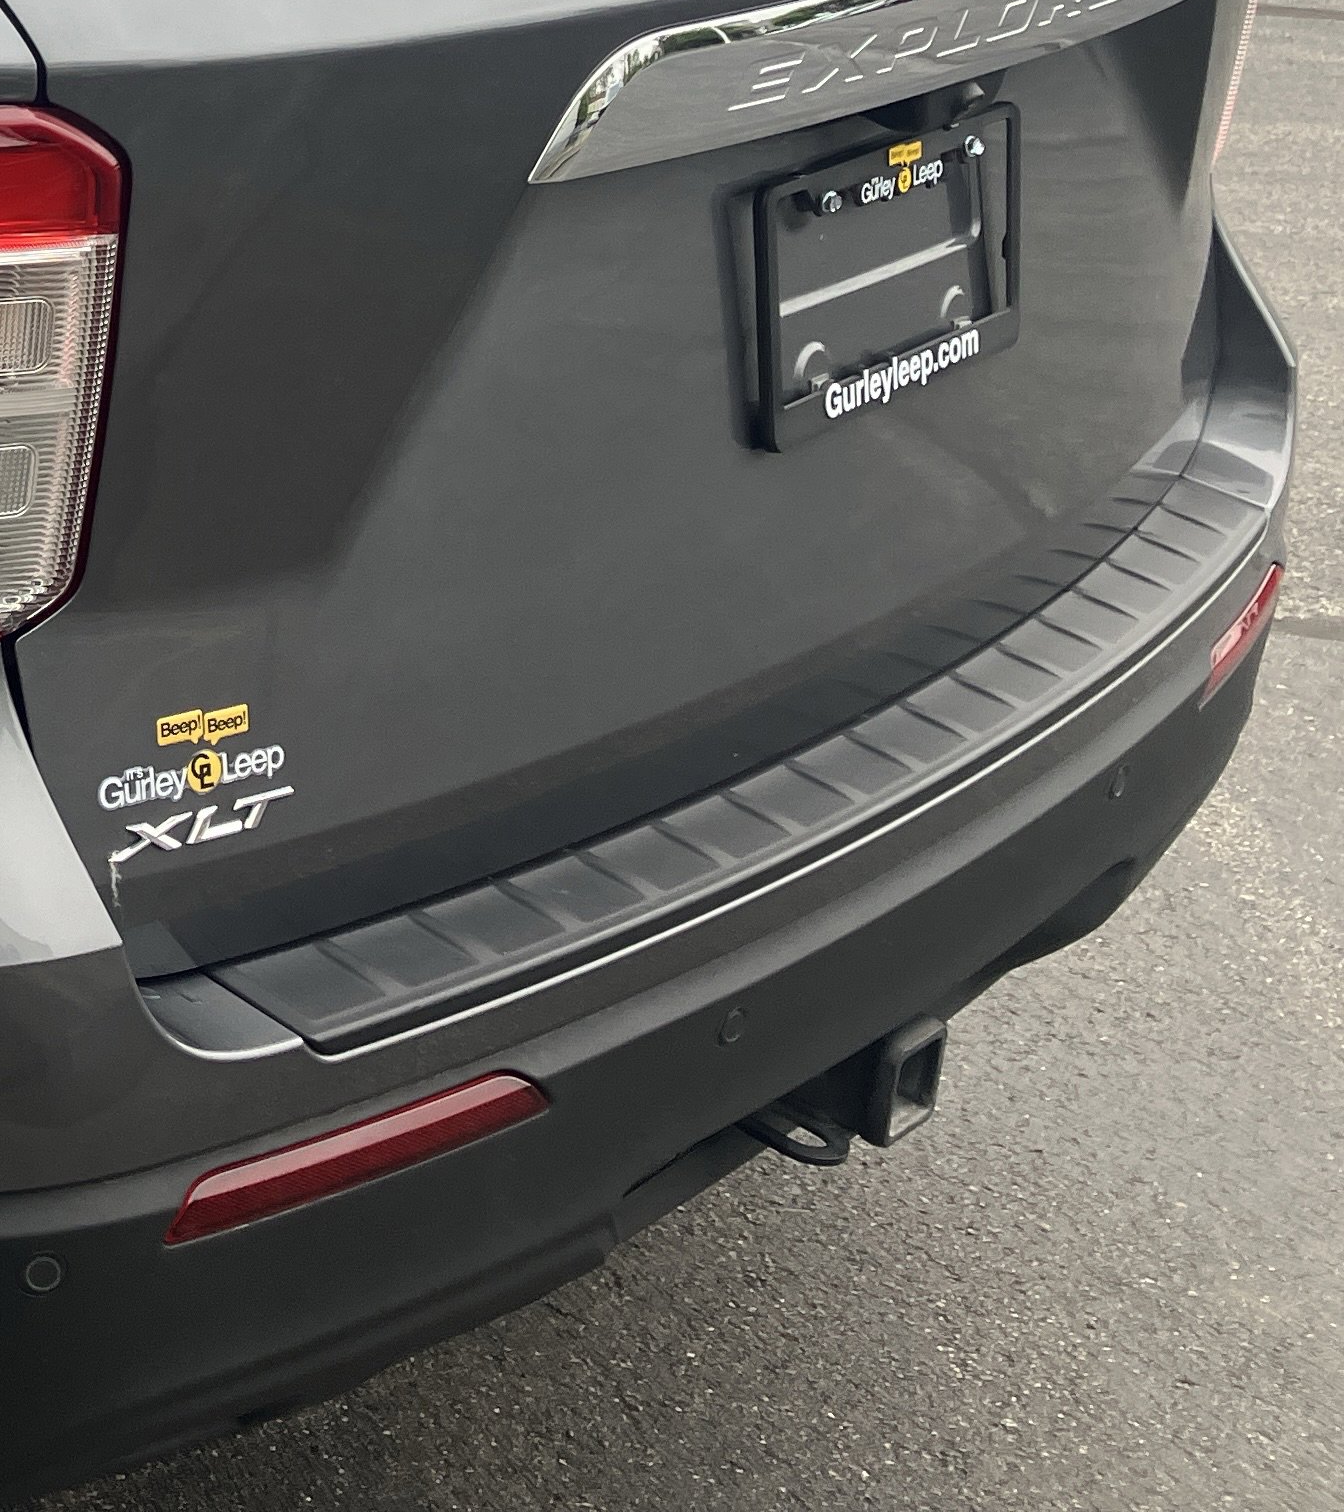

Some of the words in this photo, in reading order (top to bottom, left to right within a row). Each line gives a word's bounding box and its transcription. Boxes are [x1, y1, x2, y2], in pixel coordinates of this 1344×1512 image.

[861, 176, 896, 203] Gurley
[913, 159, 944, 186] Leep
[824, 328, 981, 419] Gurleyleep.com
[160, 714, 202, 738] Beep!
[207, 710, 247, 734] Beep!
[98, 766, 188, 810] Gurley
[222, 745, 285, 780] Leep
[108, 785, 295, 863] XLT
